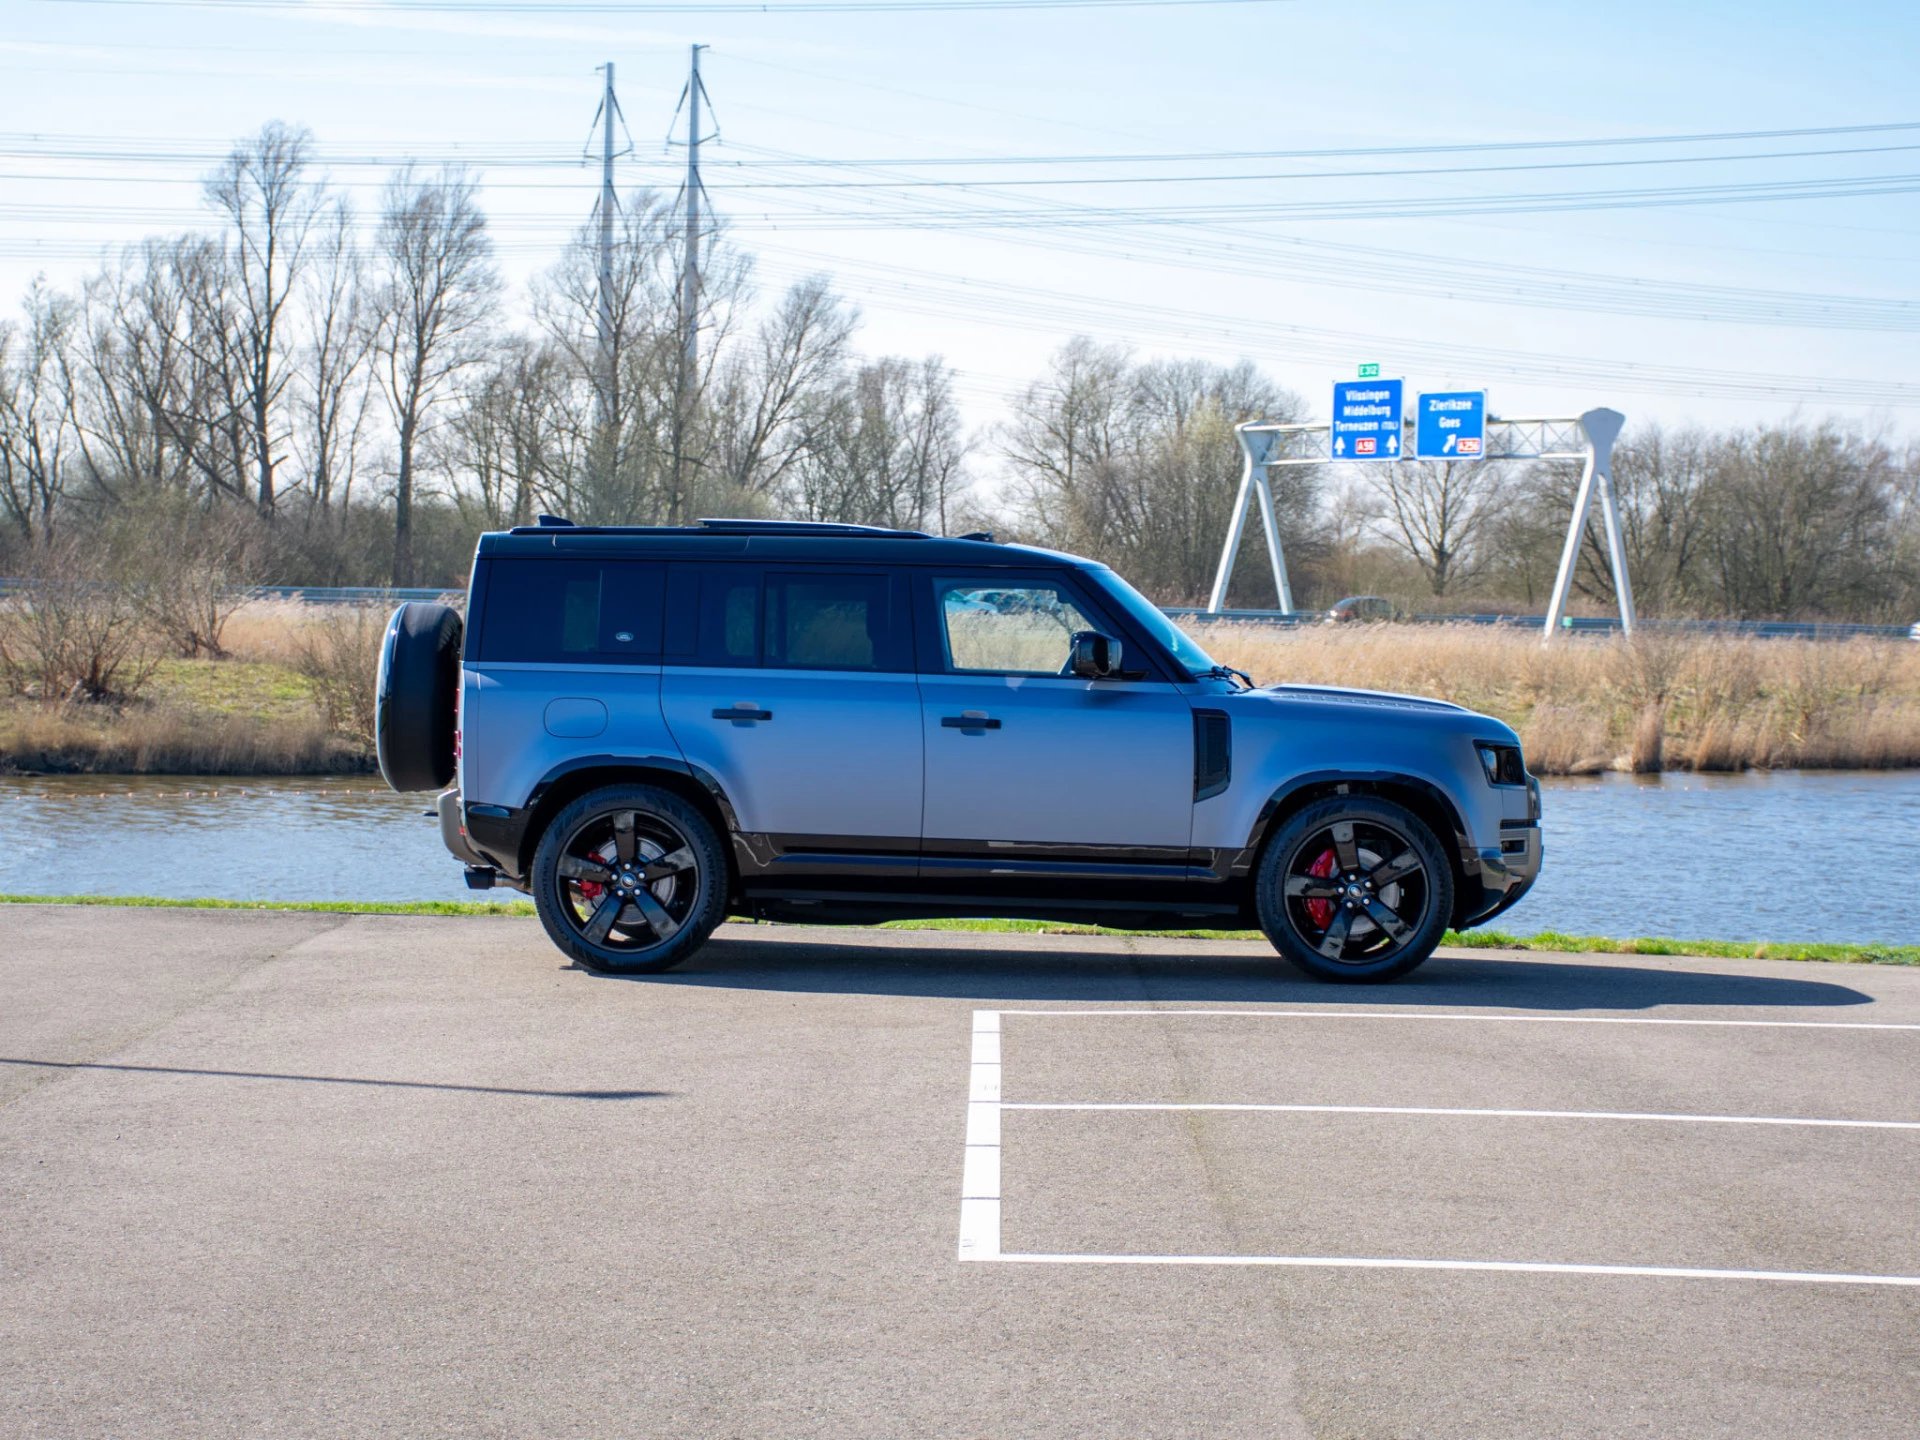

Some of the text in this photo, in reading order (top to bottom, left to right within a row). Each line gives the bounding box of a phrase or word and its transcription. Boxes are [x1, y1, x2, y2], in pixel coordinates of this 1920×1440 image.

[1346, 390, 1390, 402] Vlissingen
[1429, 399, 1472, 411] Zierikzee
[1343, 405, 1391, 418] Middelburg
[1335, 421, 1379, 432] Terneuzen
[1439, 416, 1461, 428] Goes
